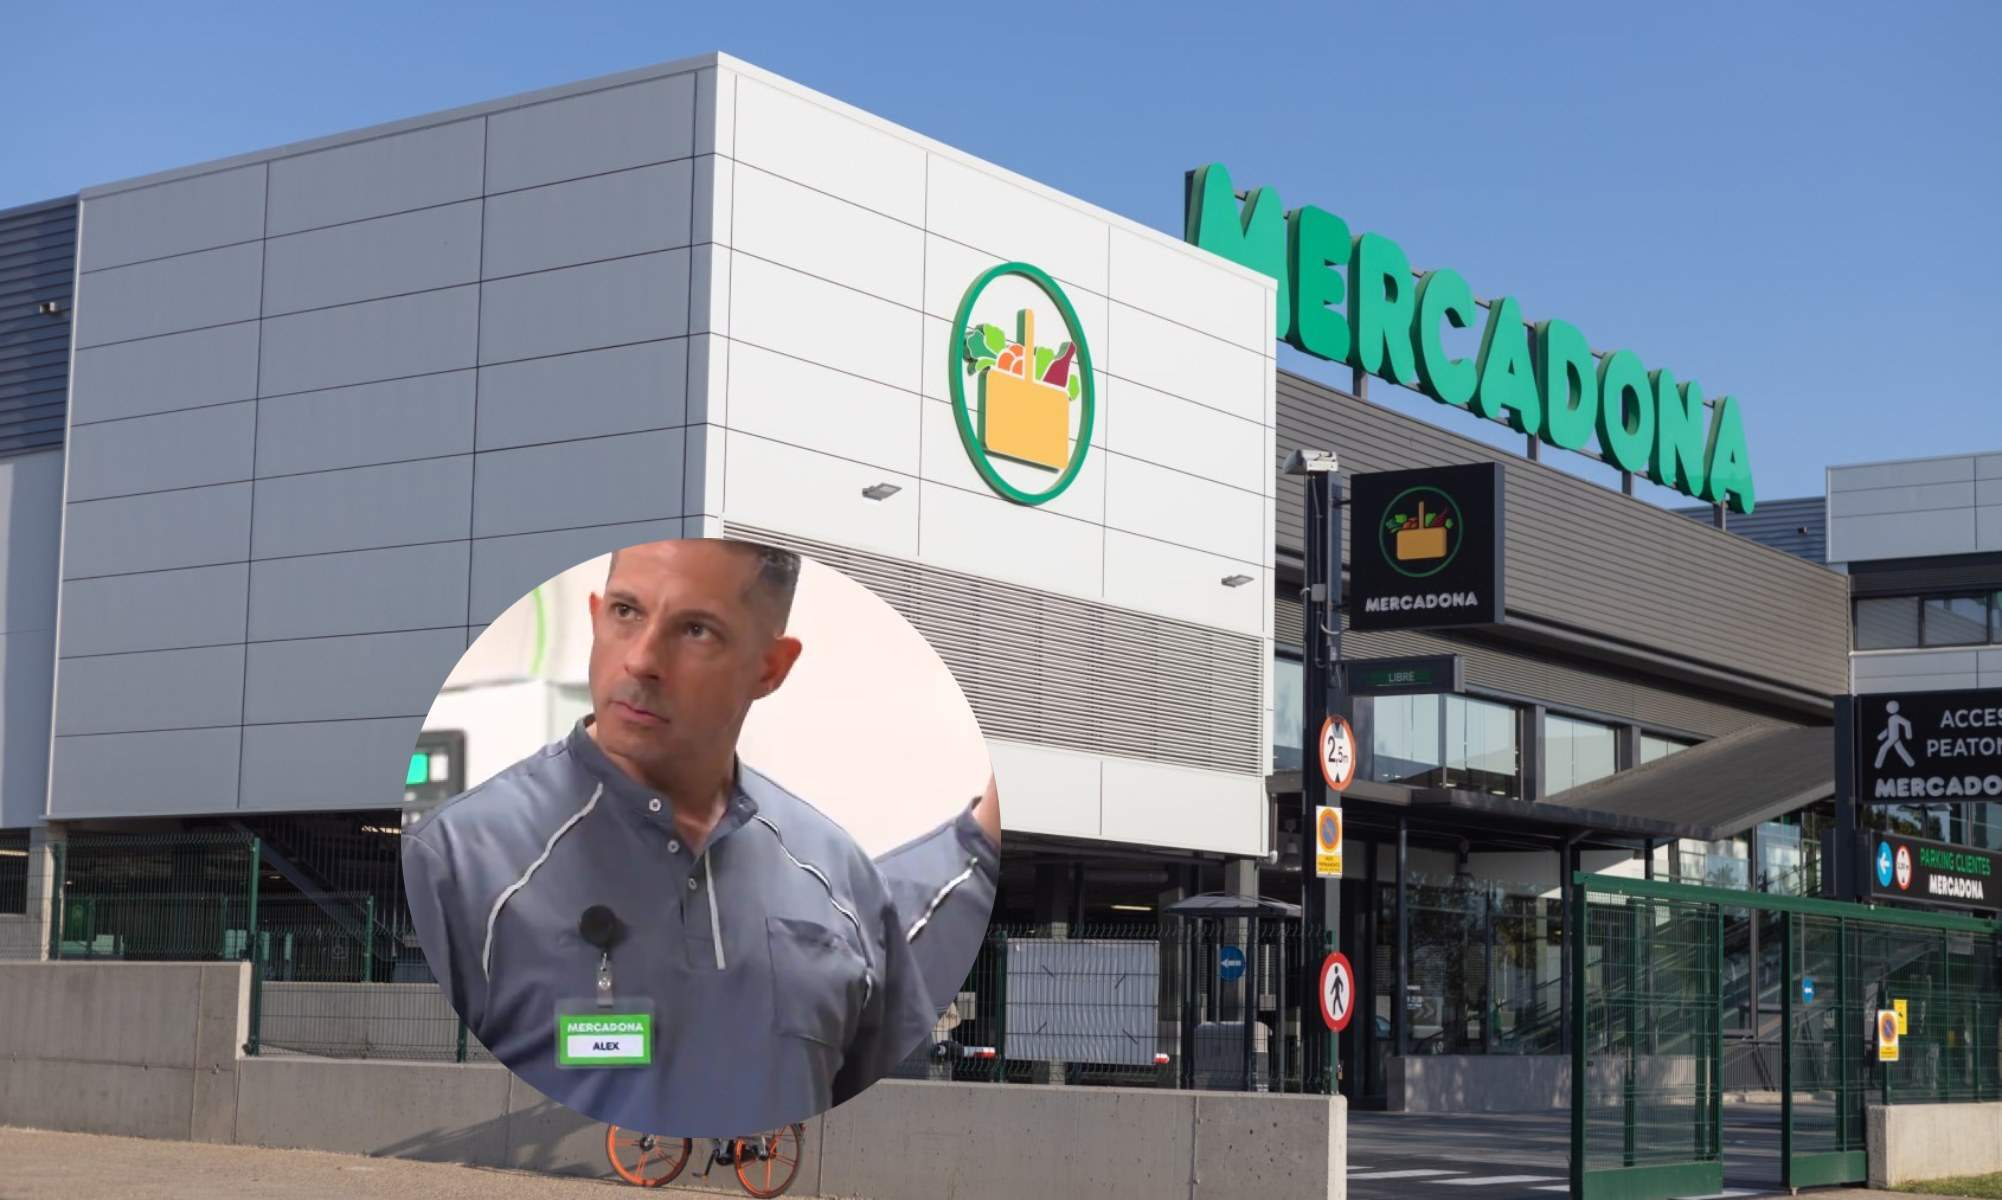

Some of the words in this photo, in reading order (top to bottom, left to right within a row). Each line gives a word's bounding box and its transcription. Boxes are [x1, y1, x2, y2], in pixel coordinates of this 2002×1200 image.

[1365, 591, 1478, 612] MERCADONA
[1388, 671, 1416, 682] LIBRE
[1920, 847, 1954, 870] PARKING
[1955, 854, 1991, 876] CLIENTES
[1929, 874, 1984, 900] MERCADONA
[567, 1022, 644, 1033] MERCADONA
[592, 1041, 620, 1051] ALEX
